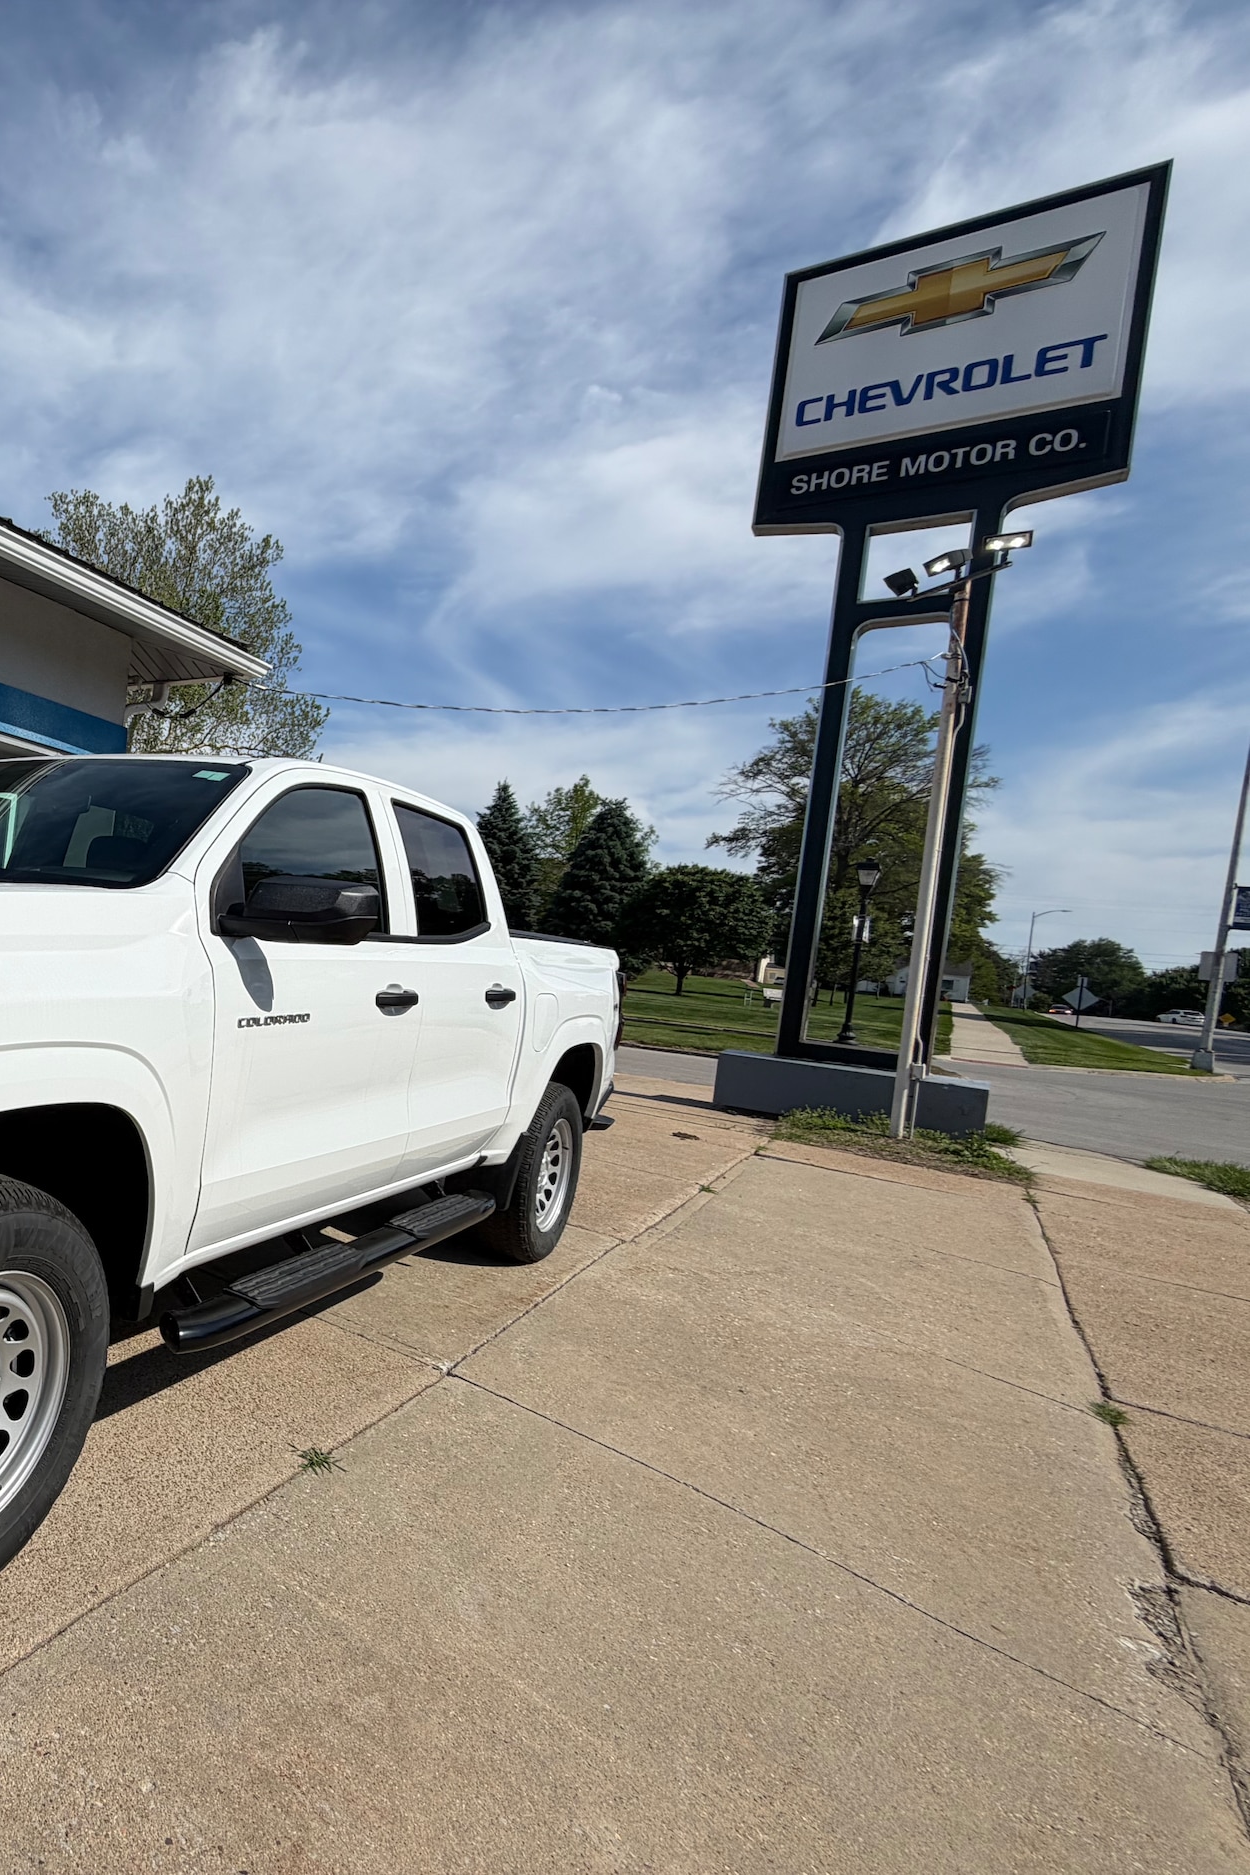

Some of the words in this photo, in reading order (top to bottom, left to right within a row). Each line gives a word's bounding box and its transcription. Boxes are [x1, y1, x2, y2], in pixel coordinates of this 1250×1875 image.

[795, 333, 1108, 428] CHEVROLET
[789, 460, 889, 496] SHORE
[899, 438, 1017, 477] MOTOR
[1028, 428, 1088, 457] CO.
[237, 1013, 311, 1029] COLORADO
